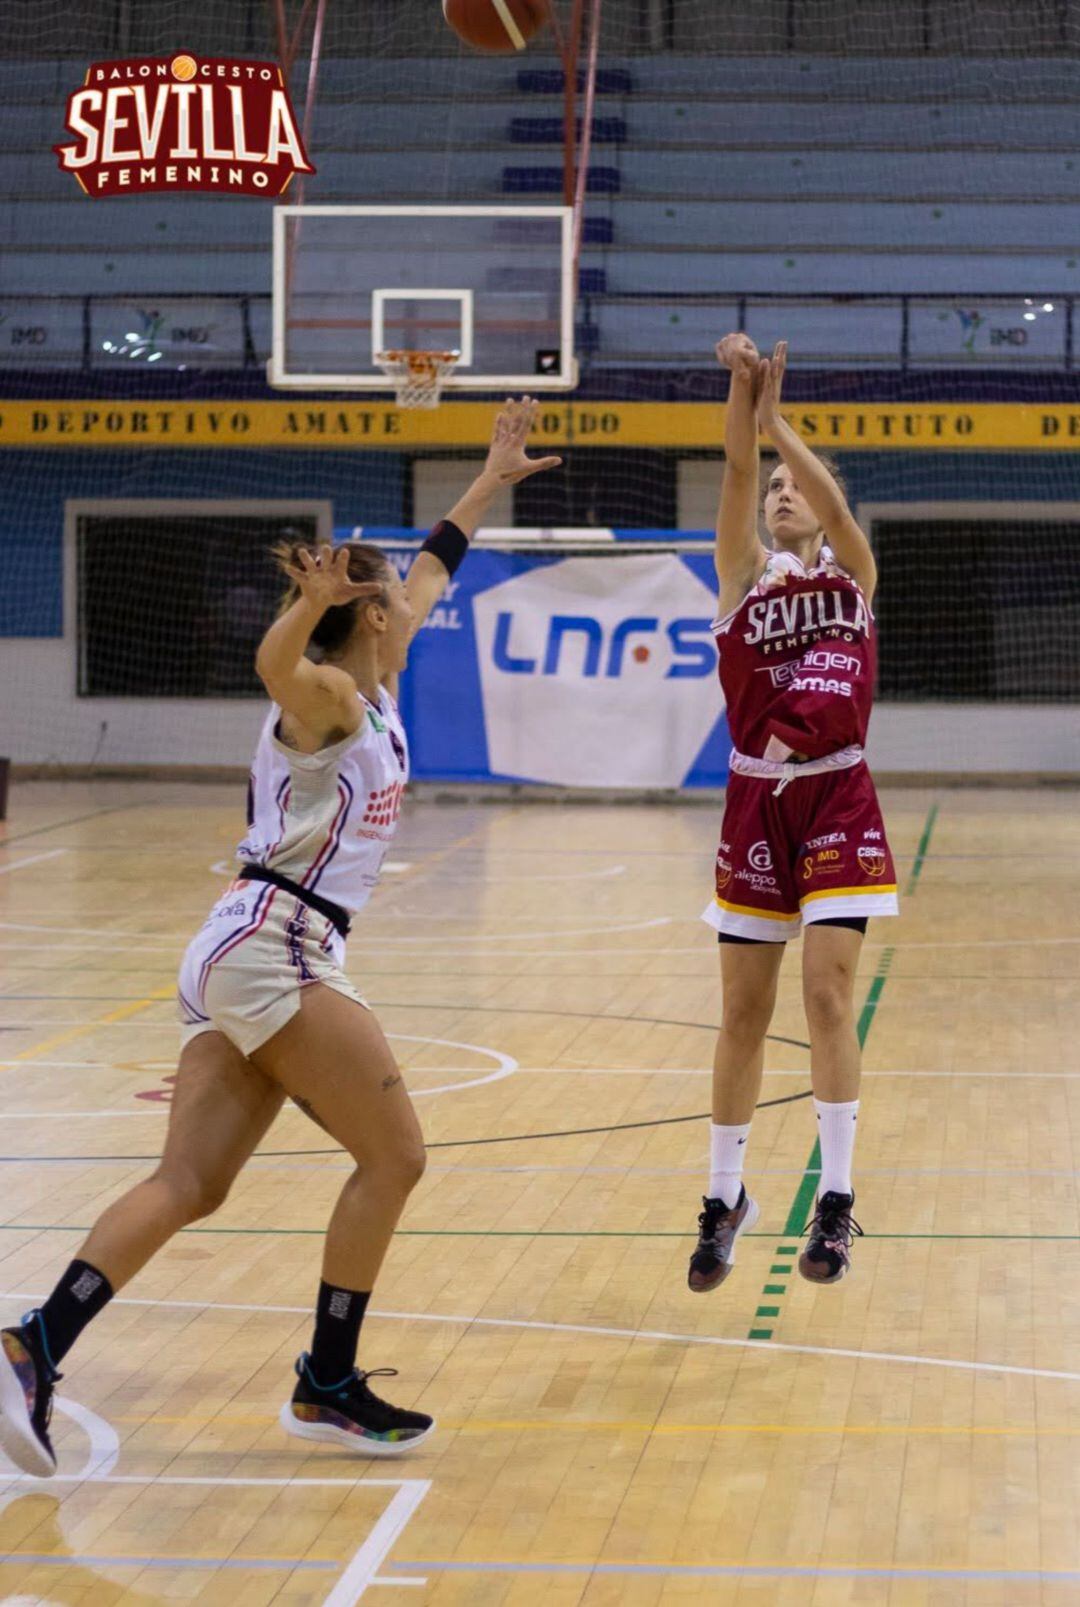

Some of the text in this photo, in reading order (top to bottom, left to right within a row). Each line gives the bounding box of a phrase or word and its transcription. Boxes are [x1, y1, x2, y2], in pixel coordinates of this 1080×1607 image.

[31, 410, 401, 433] DEPORTIVO AMATE
[757, 413, 974, 437] STITUTO
[744, 591, 870, 644] SEVILLA
[817, 849, 840, 861] IMD
[734, 868, 776, 886] aleppo
